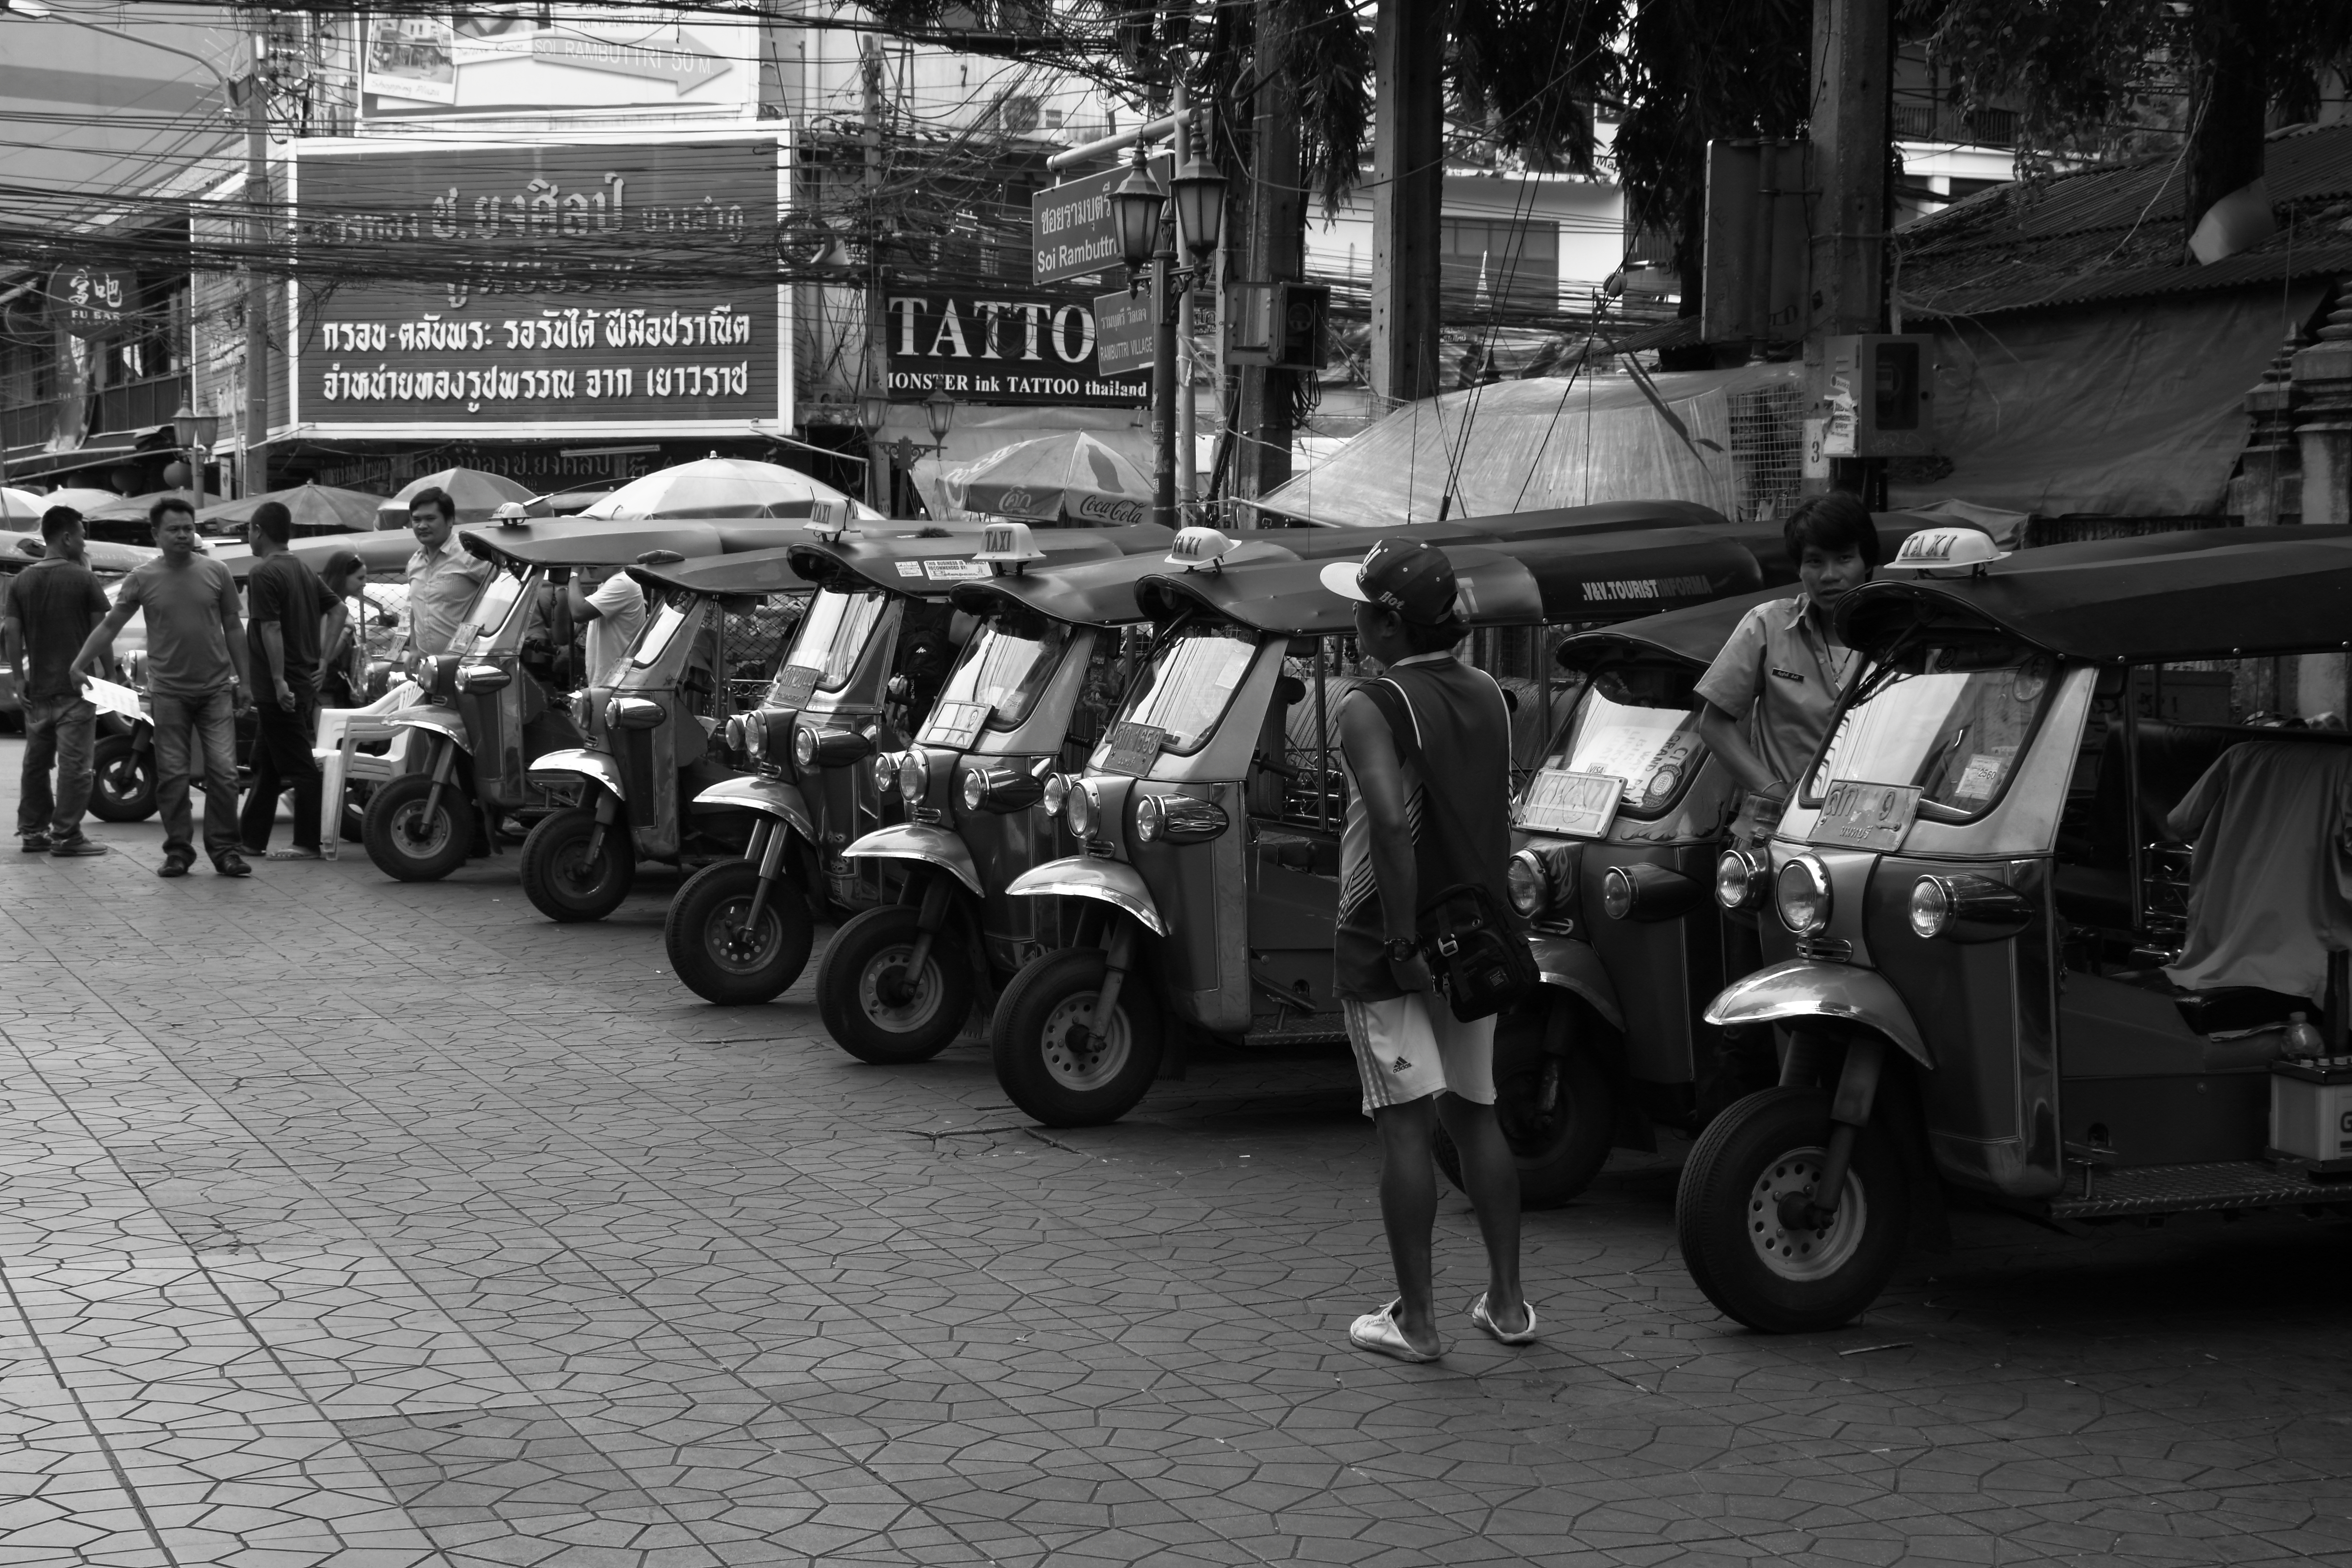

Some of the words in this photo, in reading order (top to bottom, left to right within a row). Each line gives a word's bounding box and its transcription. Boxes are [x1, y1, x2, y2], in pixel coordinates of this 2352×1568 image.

[534, 39, 556, 56] SOI
[565, 40, 661, 69] RAMBUTTRI
[671, 49, 694, 73] 50
[371, 79, 412, 96] Shopping
[416, 85, 440, 96] Plaza
[1041, 181, 1111, 235] ซอยรามบุตรี
[1038, 248, 1056, 273] Soi
[1059, 235, 1117, 268] Rambuttri
[71, 310, 88, 319] FU
[94, 311, 120, 320] BAR
[1100, 341, 1129, 362] RAMBUTTRI
[1130, 336, 1153, 355] VILLAGE
[586, 368, 632, 399] จาก
[647, 360, 748, 397] เยาวราช
[975, 375, 1001, 392] ink
[1007, 377, 1080, 395] TATTOO
[1085, 380, 1147, 398] thailand
[812, 503, 832, 524] TAXI
[1080, 495, 1143, 524] Coca-Cola
[985, 530, 1012, 553] TAXI
[1173, 535, 1202, 556] TAXI
[1901, 534, 1958, 557] TAXI
[1378, 591, 1405, 610] Hot
[1132, 727, 1160, 755] 1658
[1645, 735, 1681, 772] GRAND
[1589, 765, 1604, 774] VISA
[1661, 765, 1679, 775] RESCUE
[1978, 769, 1997, 780] 2560
[1392, 1063, 1412, 1074] adidas
